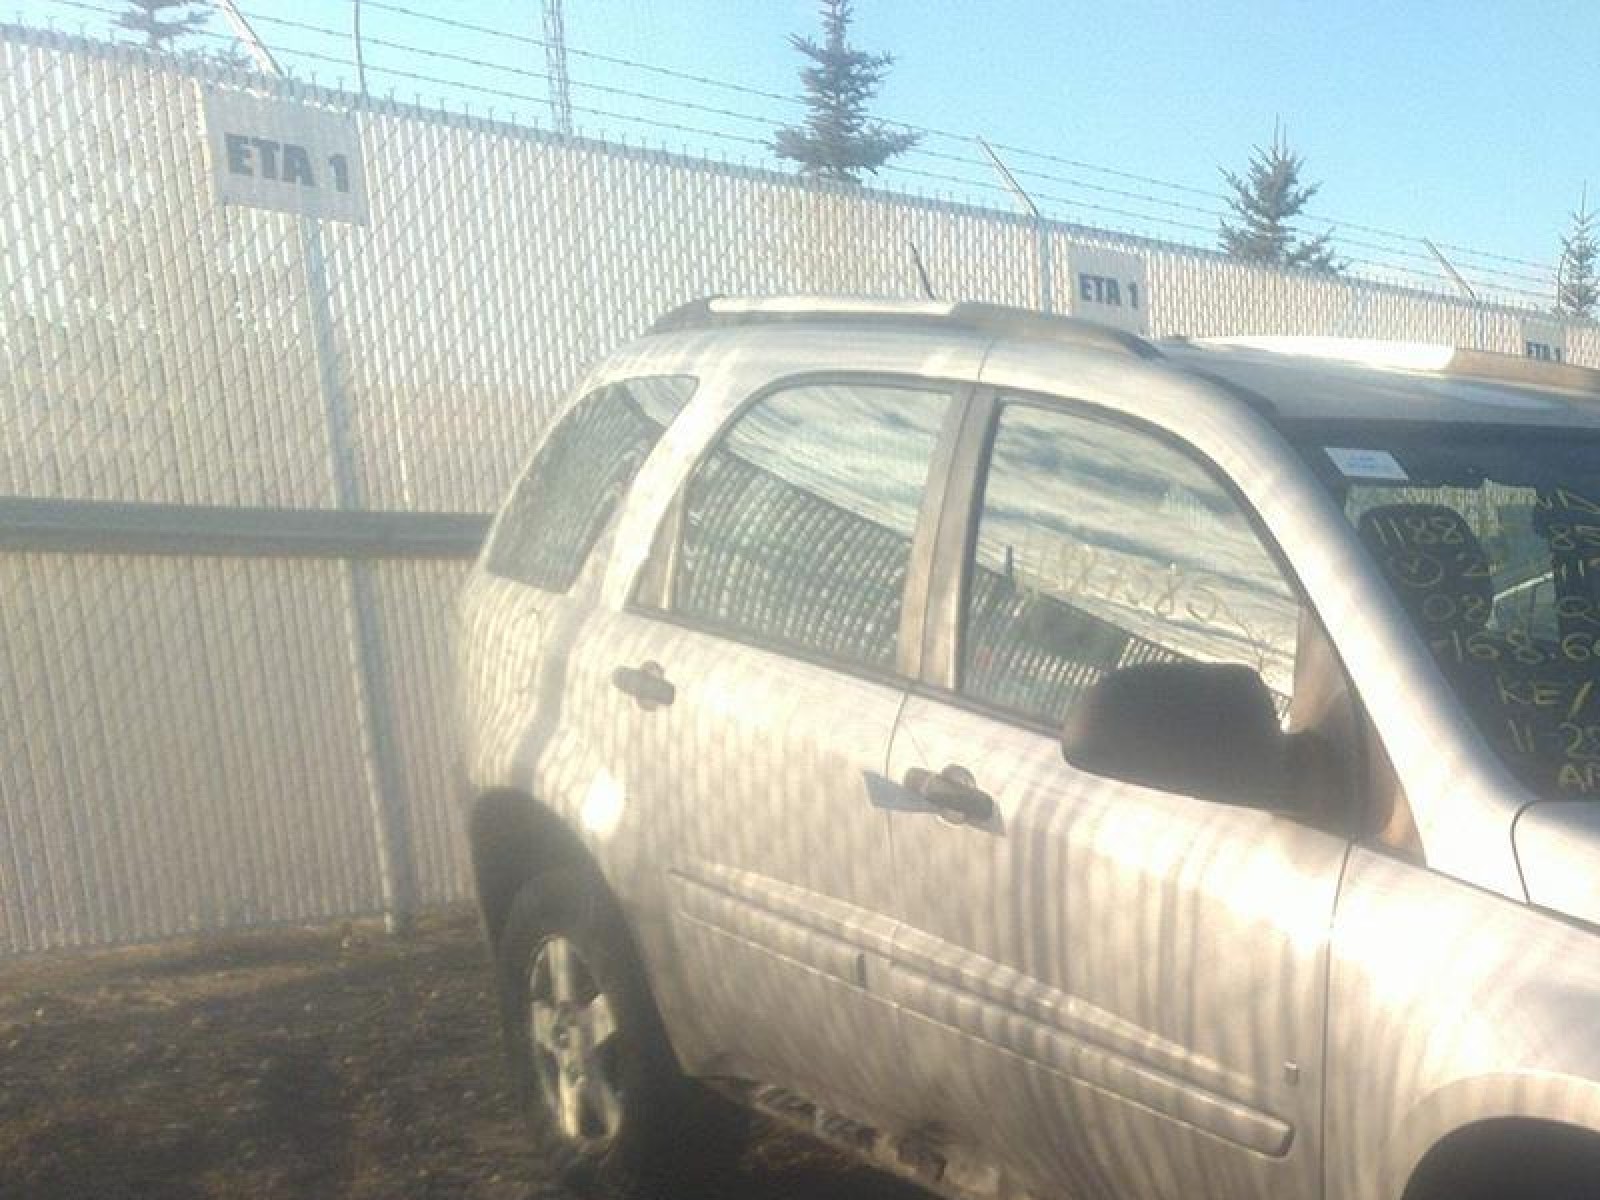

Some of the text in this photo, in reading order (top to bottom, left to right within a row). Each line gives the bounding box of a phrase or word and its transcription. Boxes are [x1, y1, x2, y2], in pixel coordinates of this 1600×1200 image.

[224, 133, 349, 192] ETA 1
[1079, 273, 1138, 310] ETA 1
